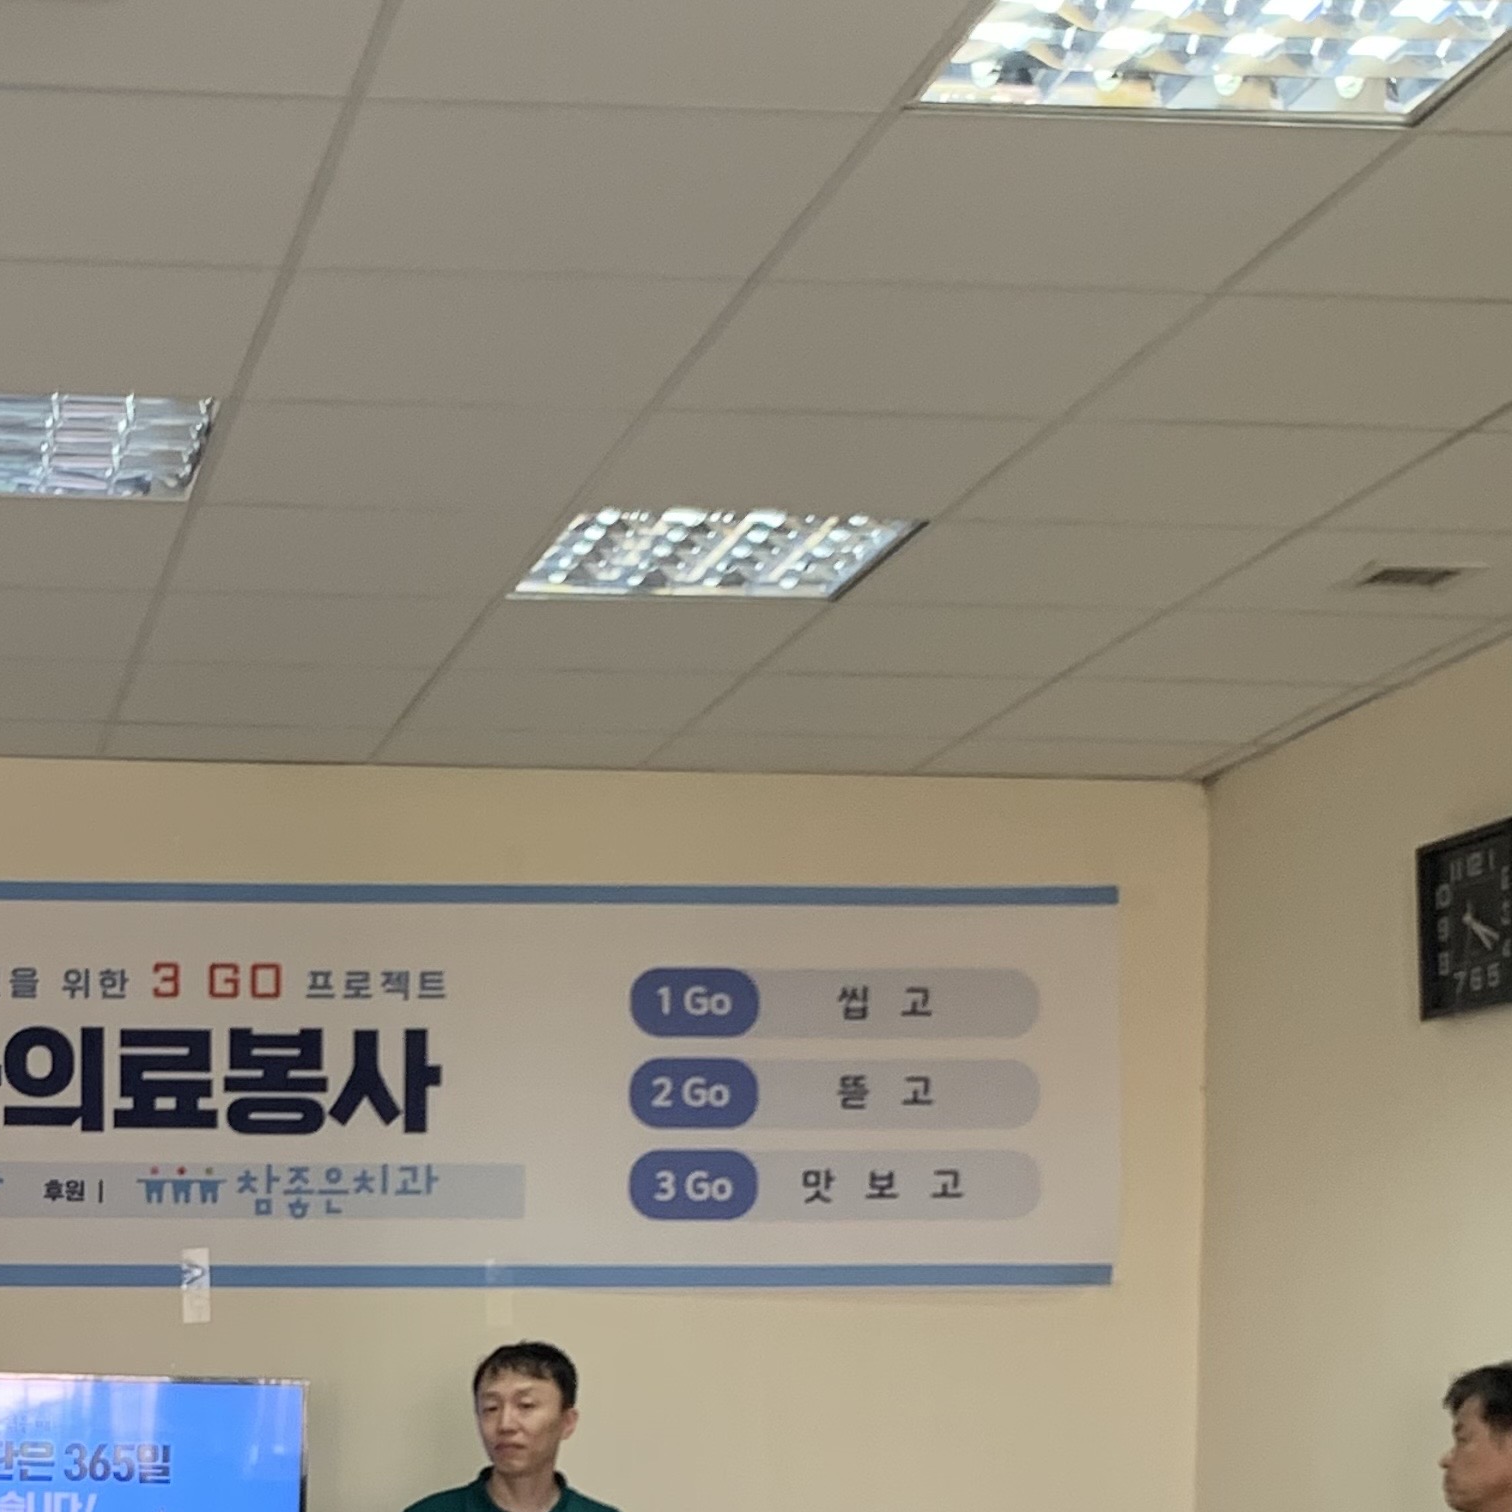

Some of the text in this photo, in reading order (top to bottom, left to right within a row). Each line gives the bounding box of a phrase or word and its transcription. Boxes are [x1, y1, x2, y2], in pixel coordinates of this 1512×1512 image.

[61, 967, 130, 999] 위한
[152, 962, 181, 999] 3
[207, 962, 283, 999] GO
[304, 969, 447, 1001] 프로젝트
[655, 985, 733, 1016] 1 Go
[650, 1075, 731, 1108] 2 Go
[42, 1163, 440, 1219] 후원 참좋은치과
[653, 1169, 734, 1202] 3 Go
[64, 1442, 171, 1484] 365일
